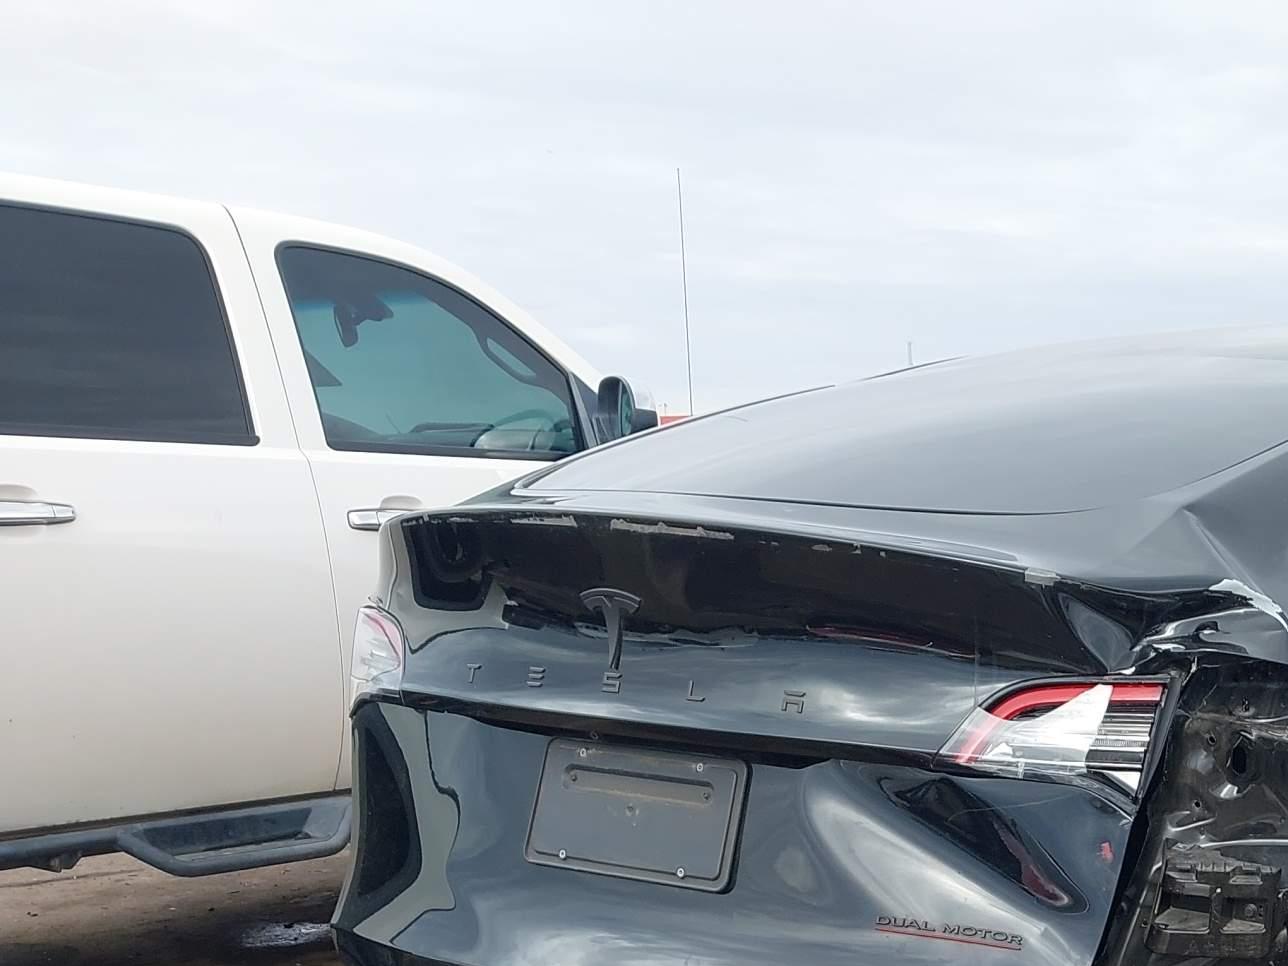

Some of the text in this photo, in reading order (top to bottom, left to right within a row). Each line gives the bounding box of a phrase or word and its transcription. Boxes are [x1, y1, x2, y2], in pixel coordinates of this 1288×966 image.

[466, 663, 807, 714] TESLA
[875, 916, 1024, 946] DUAL MOTOR
